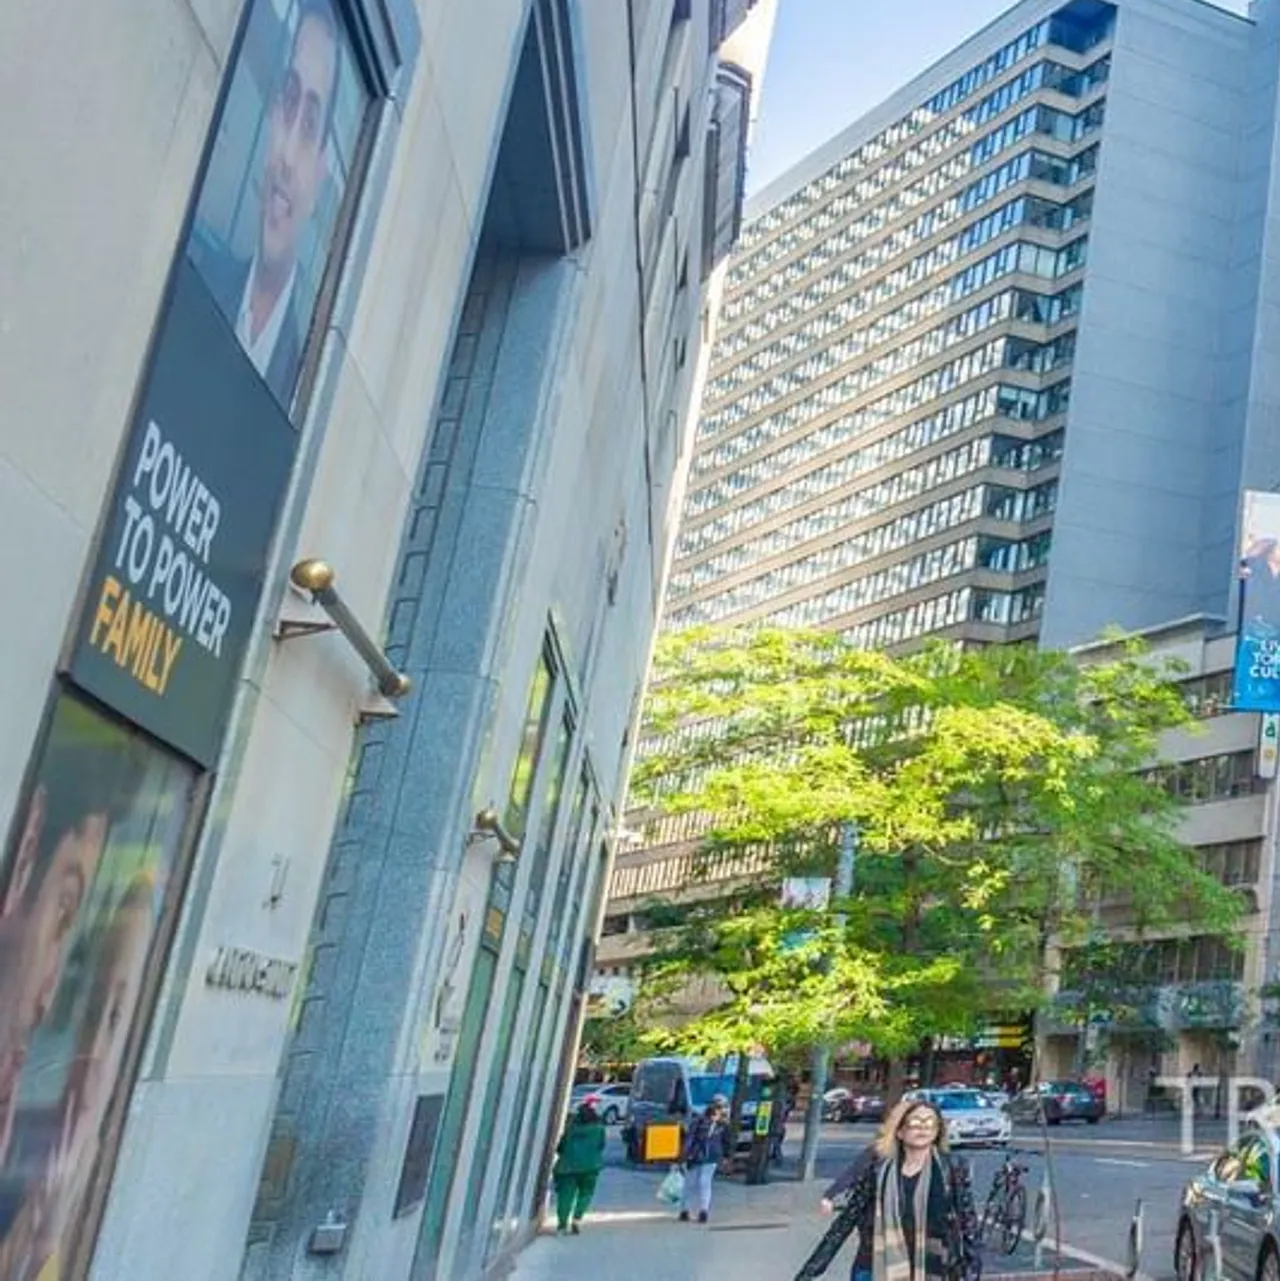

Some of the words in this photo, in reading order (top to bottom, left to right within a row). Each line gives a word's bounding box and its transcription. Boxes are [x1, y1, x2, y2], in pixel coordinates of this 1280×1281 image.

[134, 419, 220, 564] POWER
[89, 575, 182, 696] FAMILY
[115, 495, 154, 584] TO
[149, 535, 231, 658] POWER
